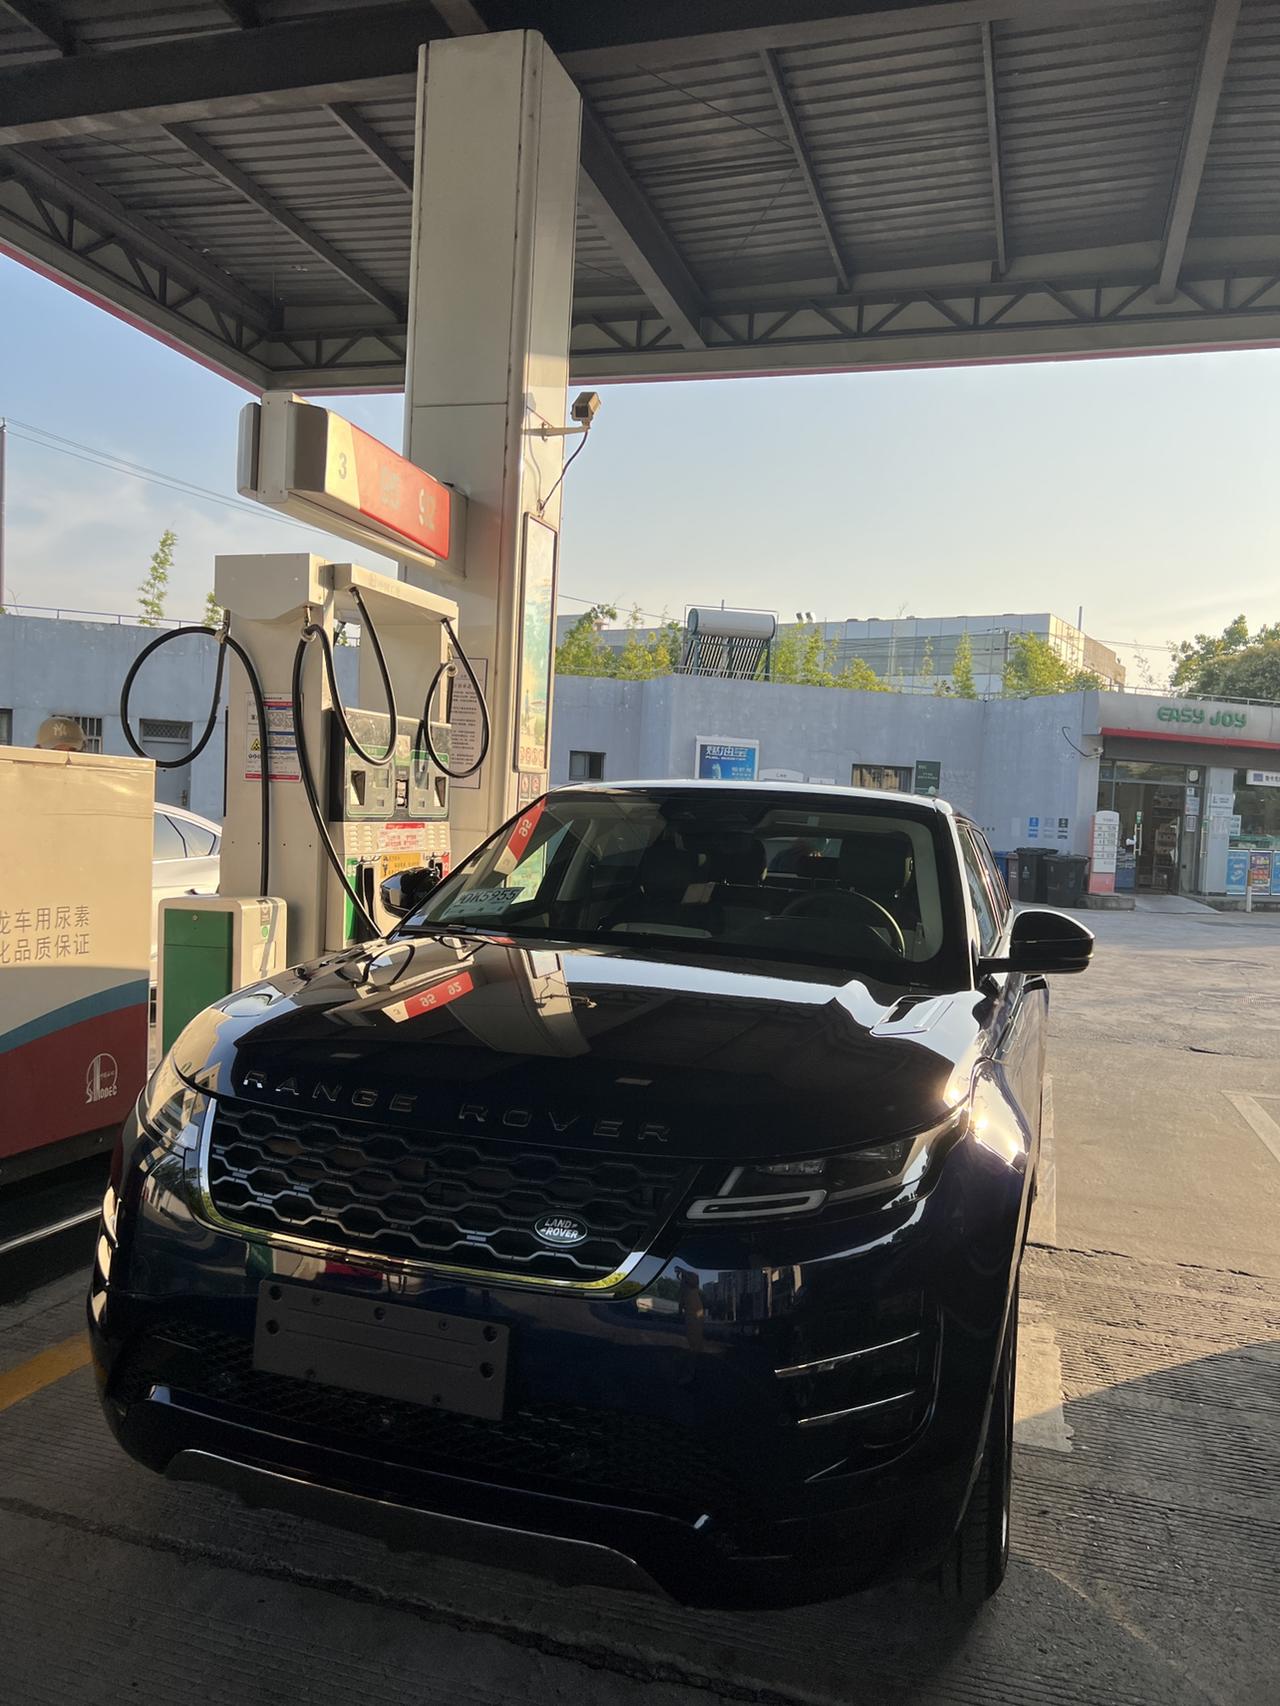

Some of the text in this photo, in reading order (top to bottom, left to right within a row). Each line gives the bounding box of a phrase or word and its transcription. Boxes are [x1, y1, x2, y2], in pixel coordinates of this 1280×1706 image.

[338, 452, 348, 480] 3
[1157, 705, 1248, 729] EASY JOY
[242, 1069, 671, 1143] RANGE ROVER
[544, 1218, 573, 1229] LAND
[544, 1226, 580, 1239] ROVER
